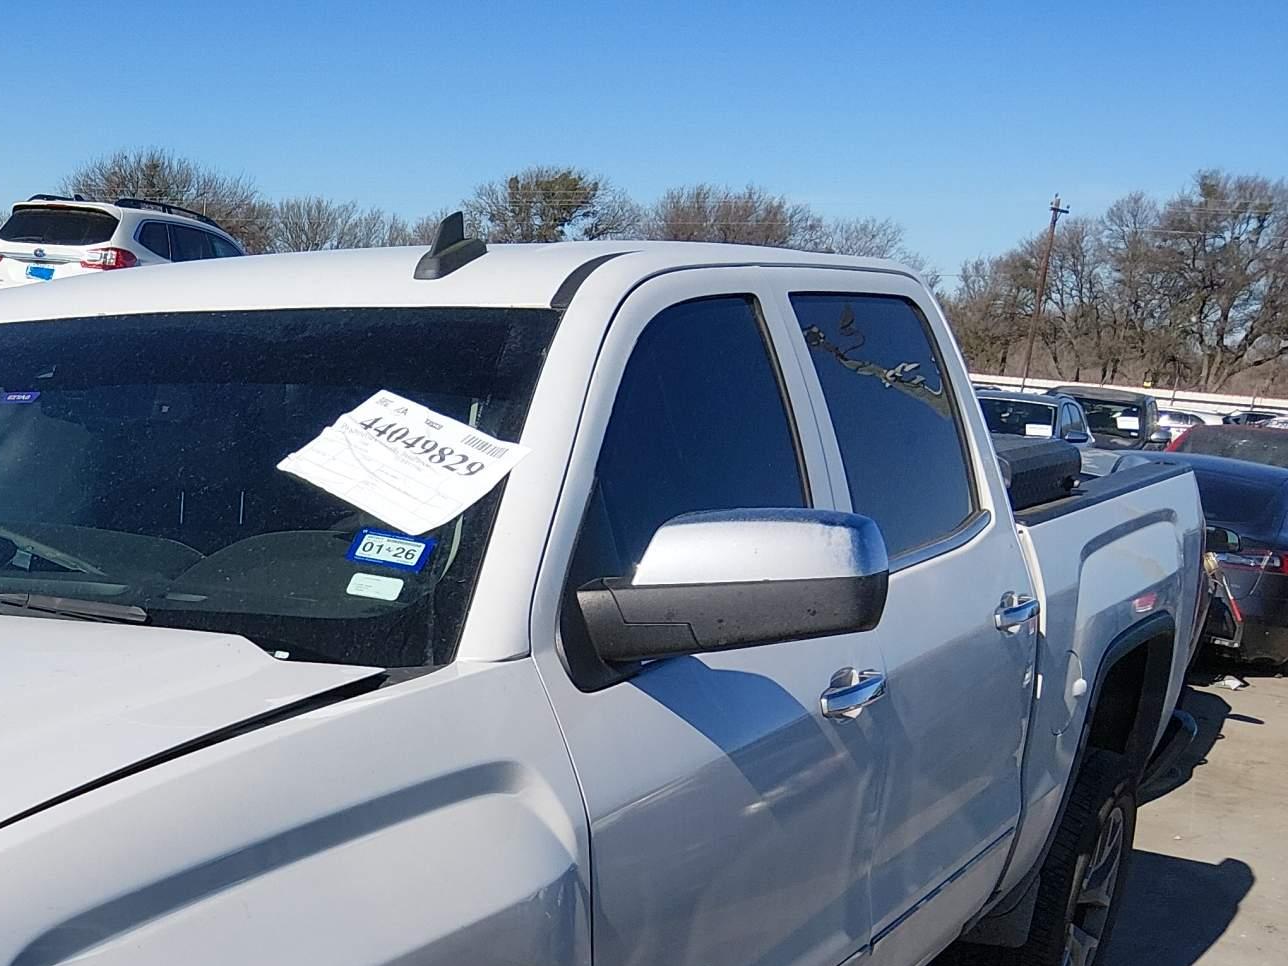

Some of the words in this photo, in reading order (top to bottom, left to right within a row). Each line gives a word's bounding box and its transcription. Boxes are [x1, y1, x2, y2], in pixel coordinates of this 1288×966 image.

[358, 416, 485, 476] 44049829
[362, 541, 384, 554] 01
[392, 546, 417, 560] 26
